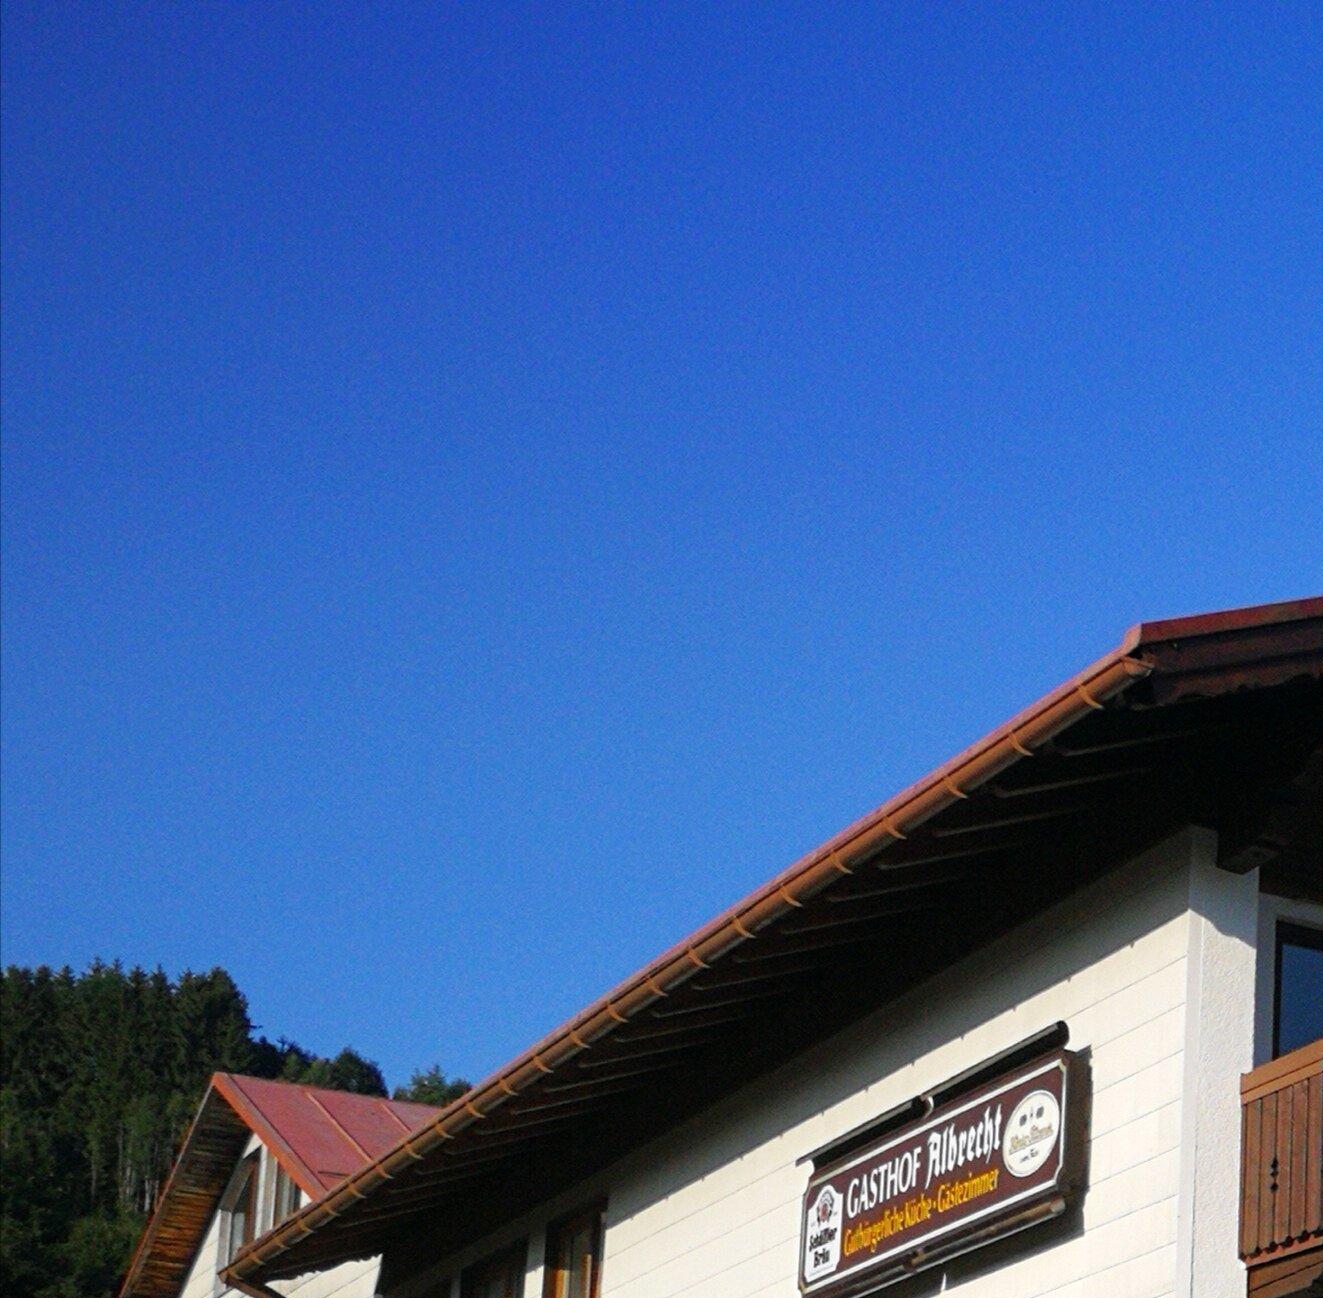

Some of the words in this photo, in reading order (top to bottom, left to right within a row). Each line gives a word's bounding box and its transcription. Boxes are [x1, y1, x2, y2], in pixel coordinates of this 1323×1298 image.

[847, 1146, 922, 1219] GASTHOF
[924, 1103, 1002, 1189] Albrecht
[844, 1206, 904, 1257] Gutbürgerliche
[904, 1192, 932, 1230] Küche
[937, 1168, 1000, 1213] Gästezimmer
[813, 1247, 831, 1268] Bräu
